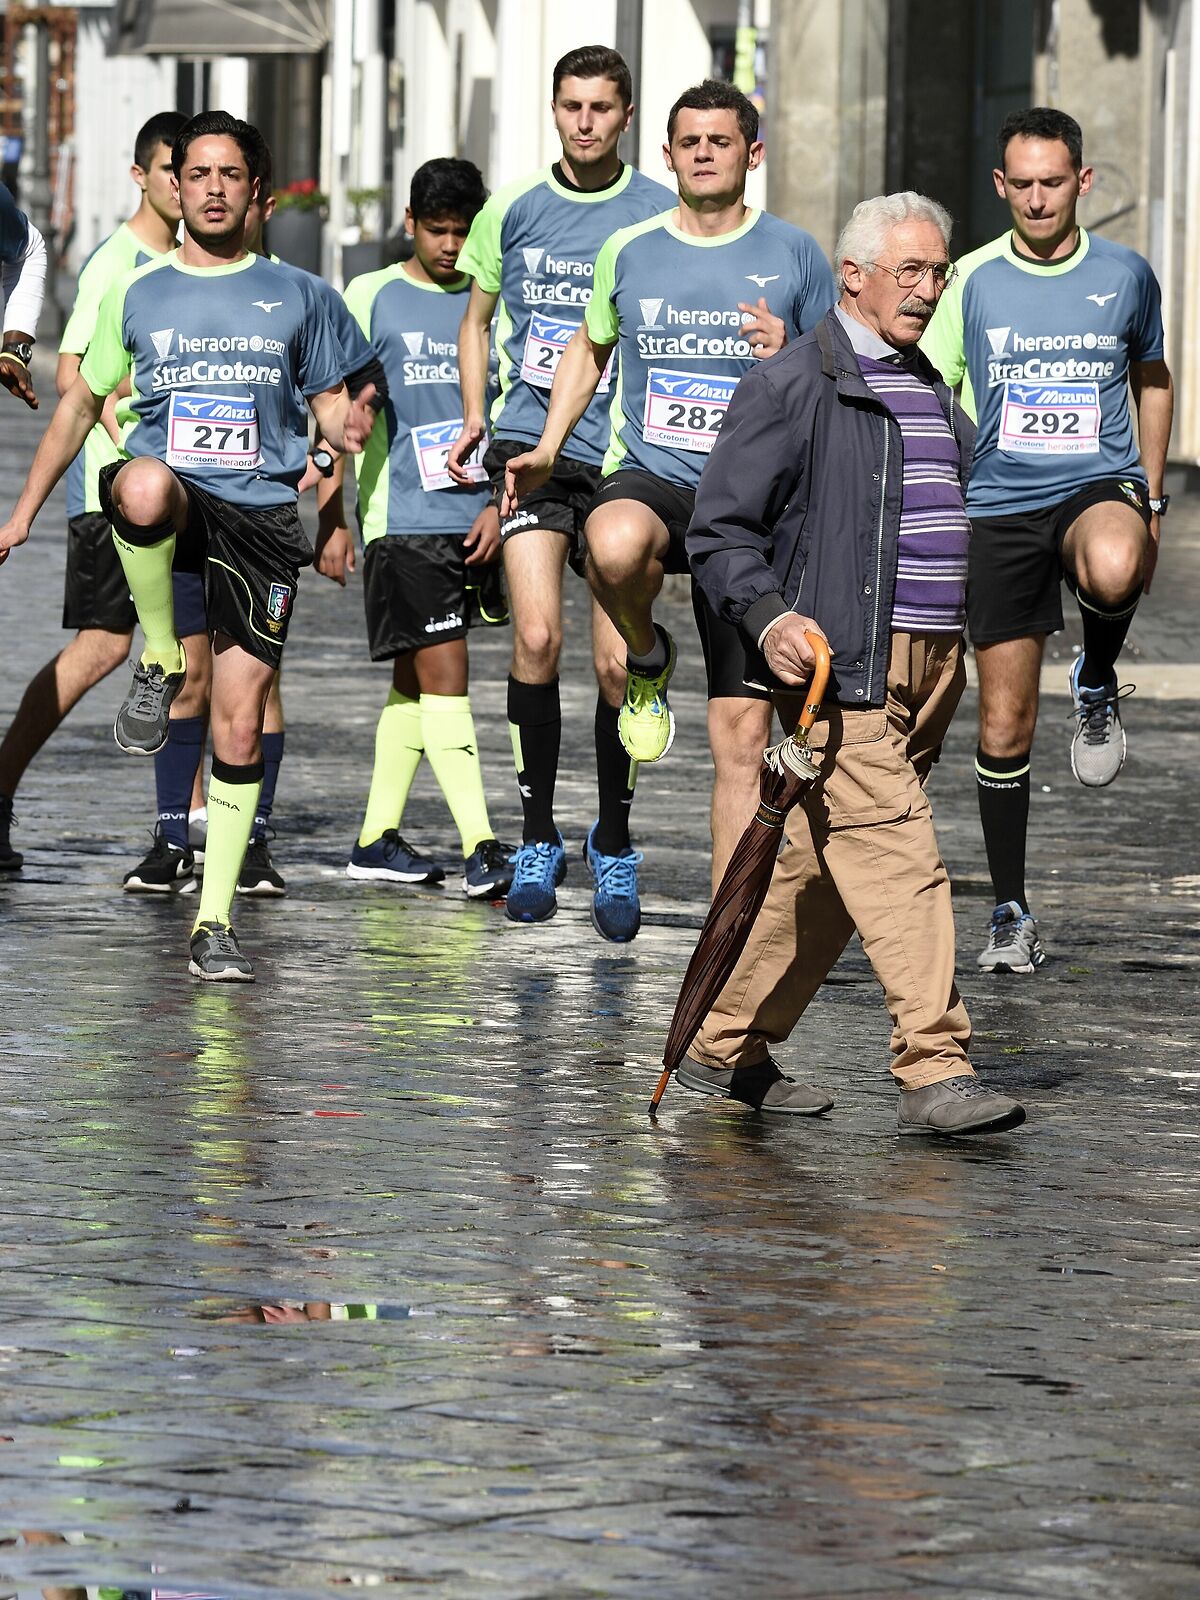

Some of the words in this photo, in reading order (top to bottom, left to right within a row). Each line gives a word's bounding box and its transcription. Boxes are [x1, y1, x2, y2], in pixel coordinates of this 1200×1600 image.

[667, 304, 739, 326] heraora
[178, 333, 248, 353] heraora
[264, 338, 286, 354] com
[1013, 332, 1083, 352] heraora
[1097, 335, 1118, 346] com
[151, 360, 282, 388] StraCrotone
[988, 358, 1115, 382] StraCrotone
[666, 403, 728, 432] 282
[1021, 412, 1080, 434] 292
[193, 425, 251, 451] 271
[424, 612, 463, 633] diadora
